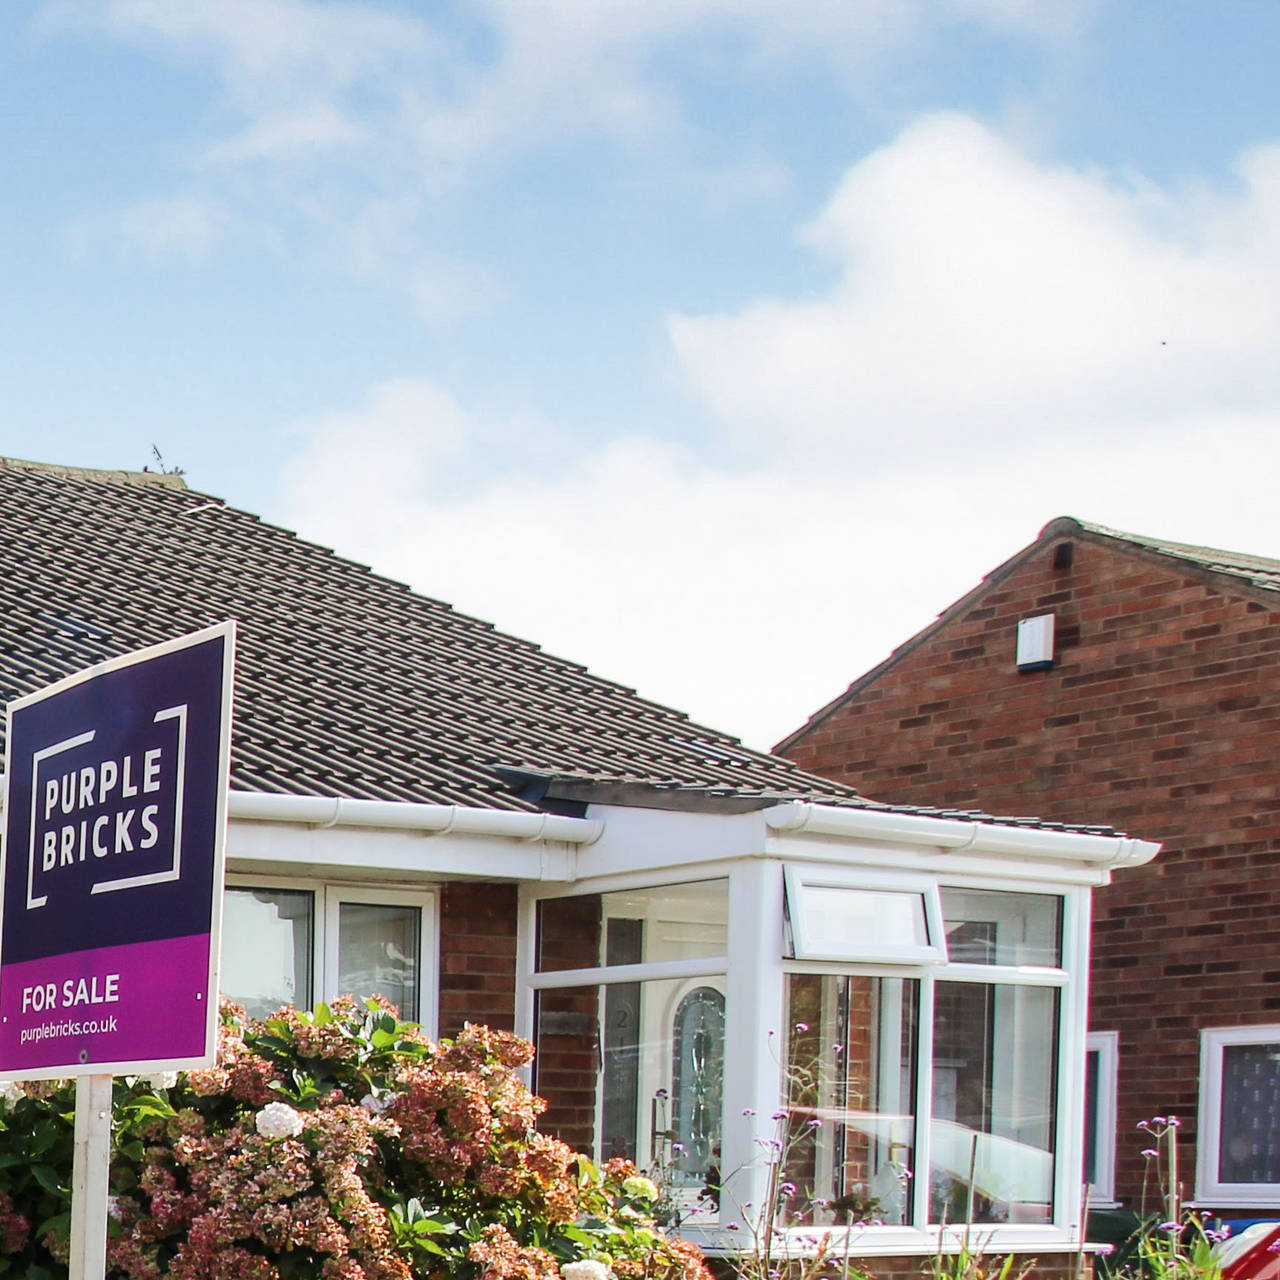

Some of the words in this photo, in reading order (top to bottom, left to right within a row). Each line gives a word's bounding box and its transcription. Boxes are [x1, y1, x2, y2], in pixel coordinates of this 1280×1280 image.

[45, 748, 161, 820] PURPLE
[42, 805, 159, 872] BRICKS
[22, 986, 57, 1013] FOR
[62, 974, 120, 1007] SALE
[20, 1015, 118, 1045] purplebricks.co.uk
